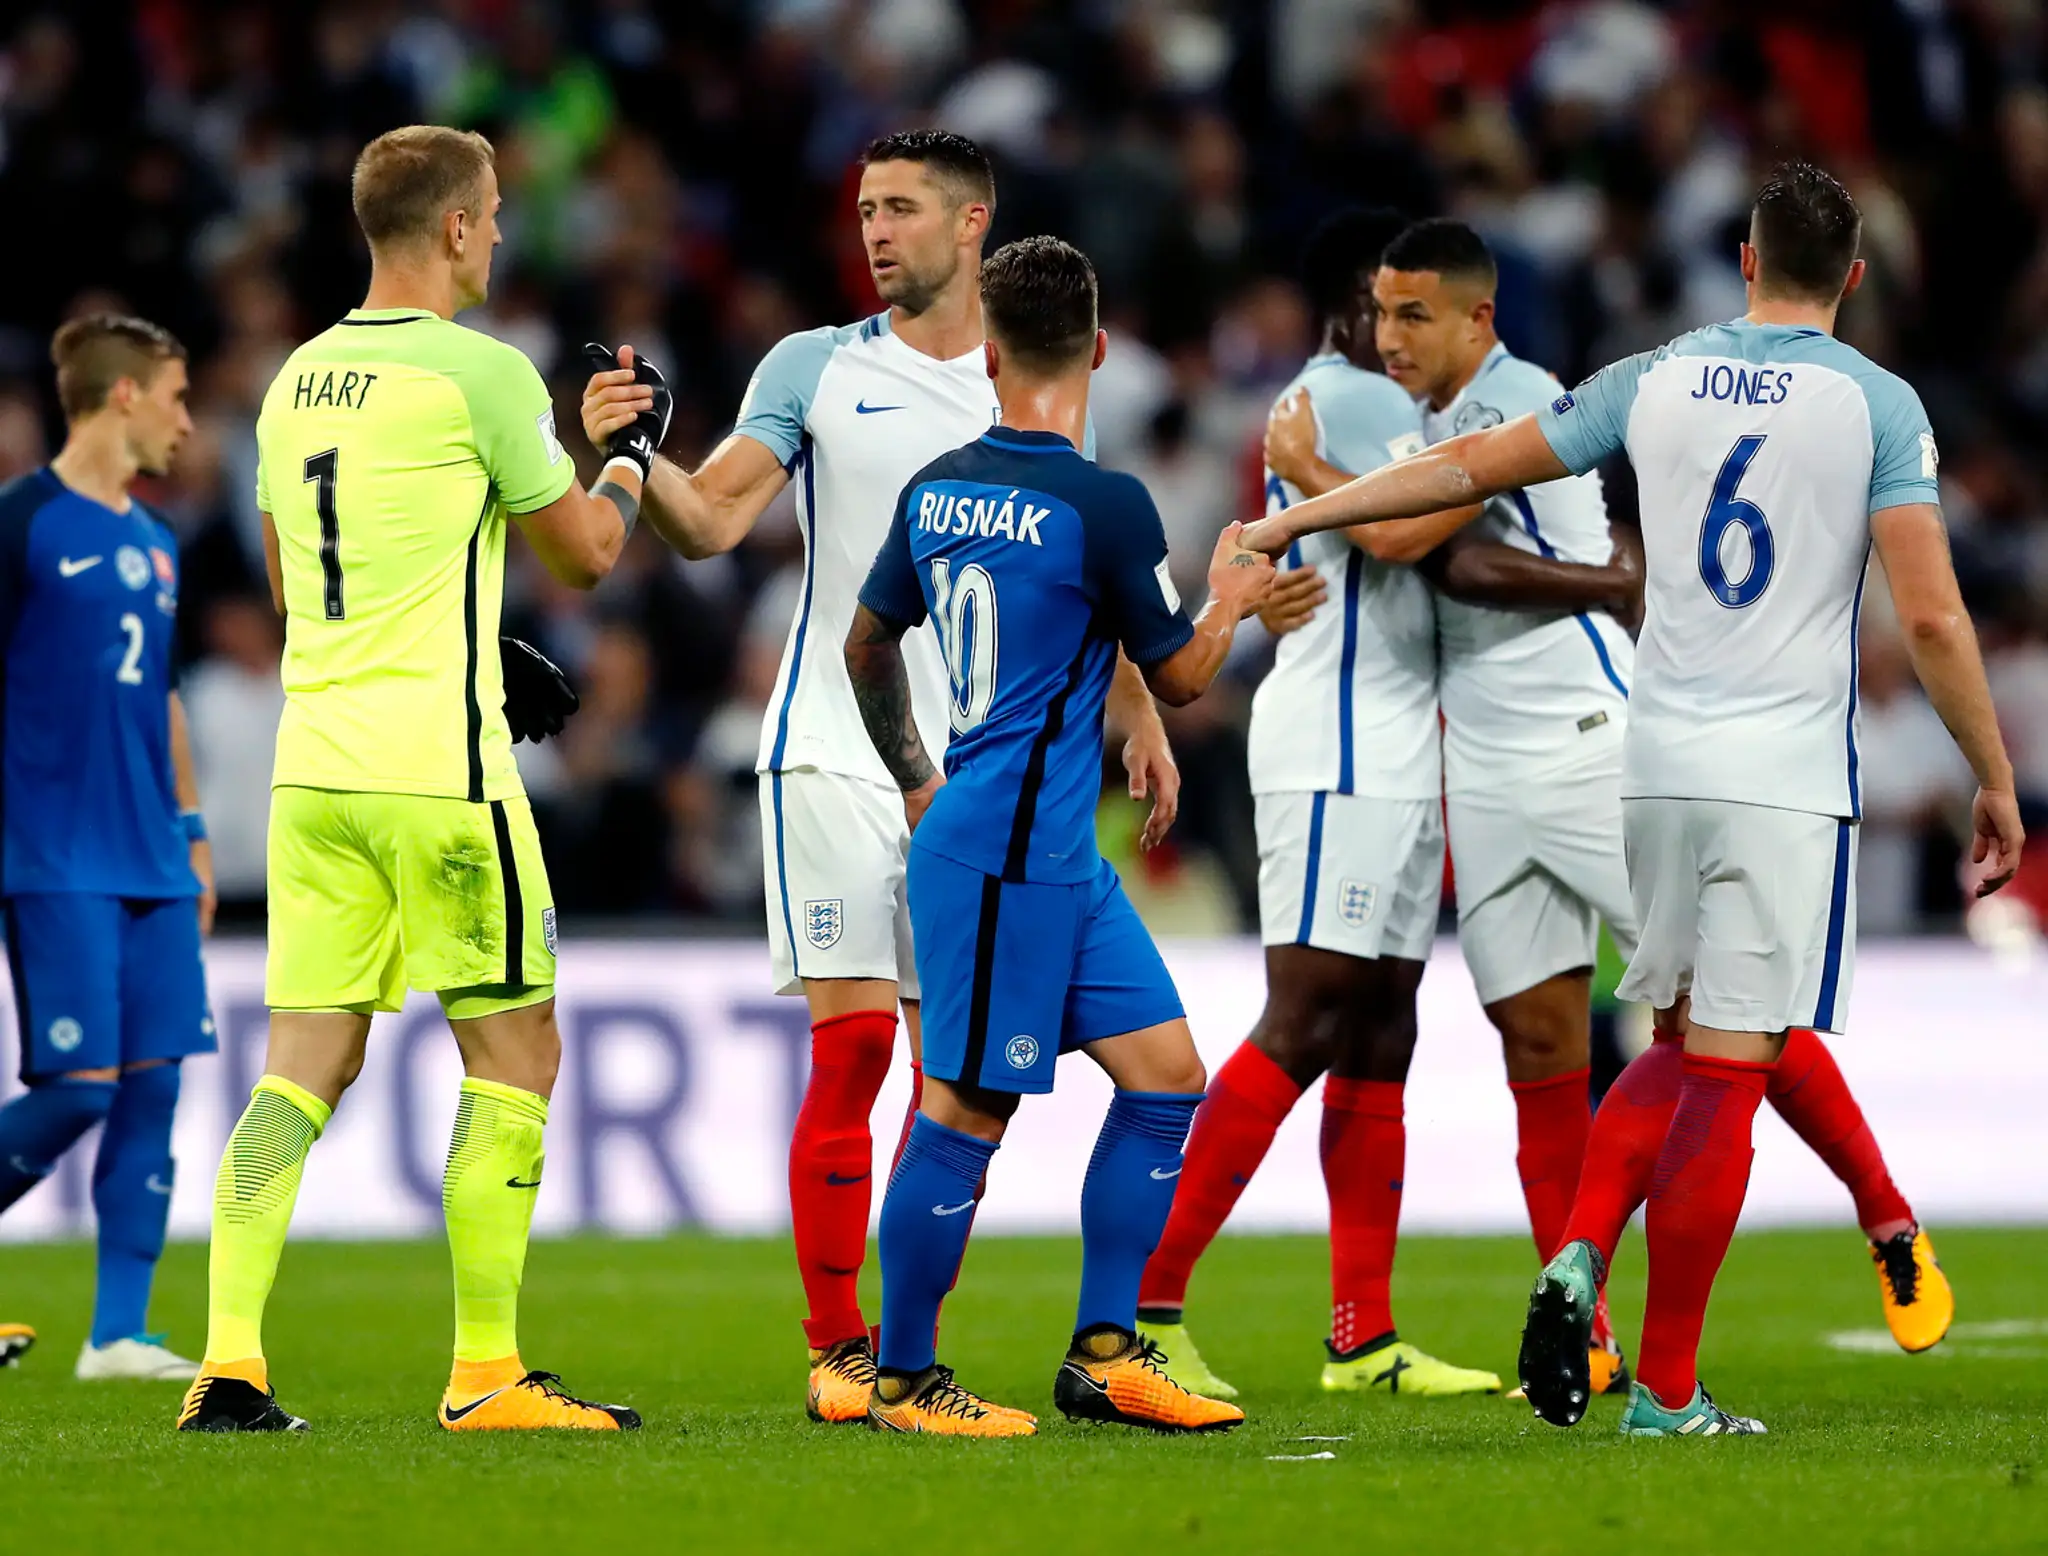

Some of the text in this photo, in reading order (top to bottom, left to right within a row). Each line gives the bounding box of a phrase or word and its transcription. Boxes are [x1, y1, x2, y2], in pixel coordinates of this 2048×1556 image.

[294, 371, 378, 410] HART
[1691, 365, 1793, 405] JONES
[303, 447, 345, 620] 1
[918, 489, 1051, 547] RUSNÁK
[1698, 434, 1775, 609] 6
[116, 612, 144, 686] 2
[930, 558, 999, 737] 10
